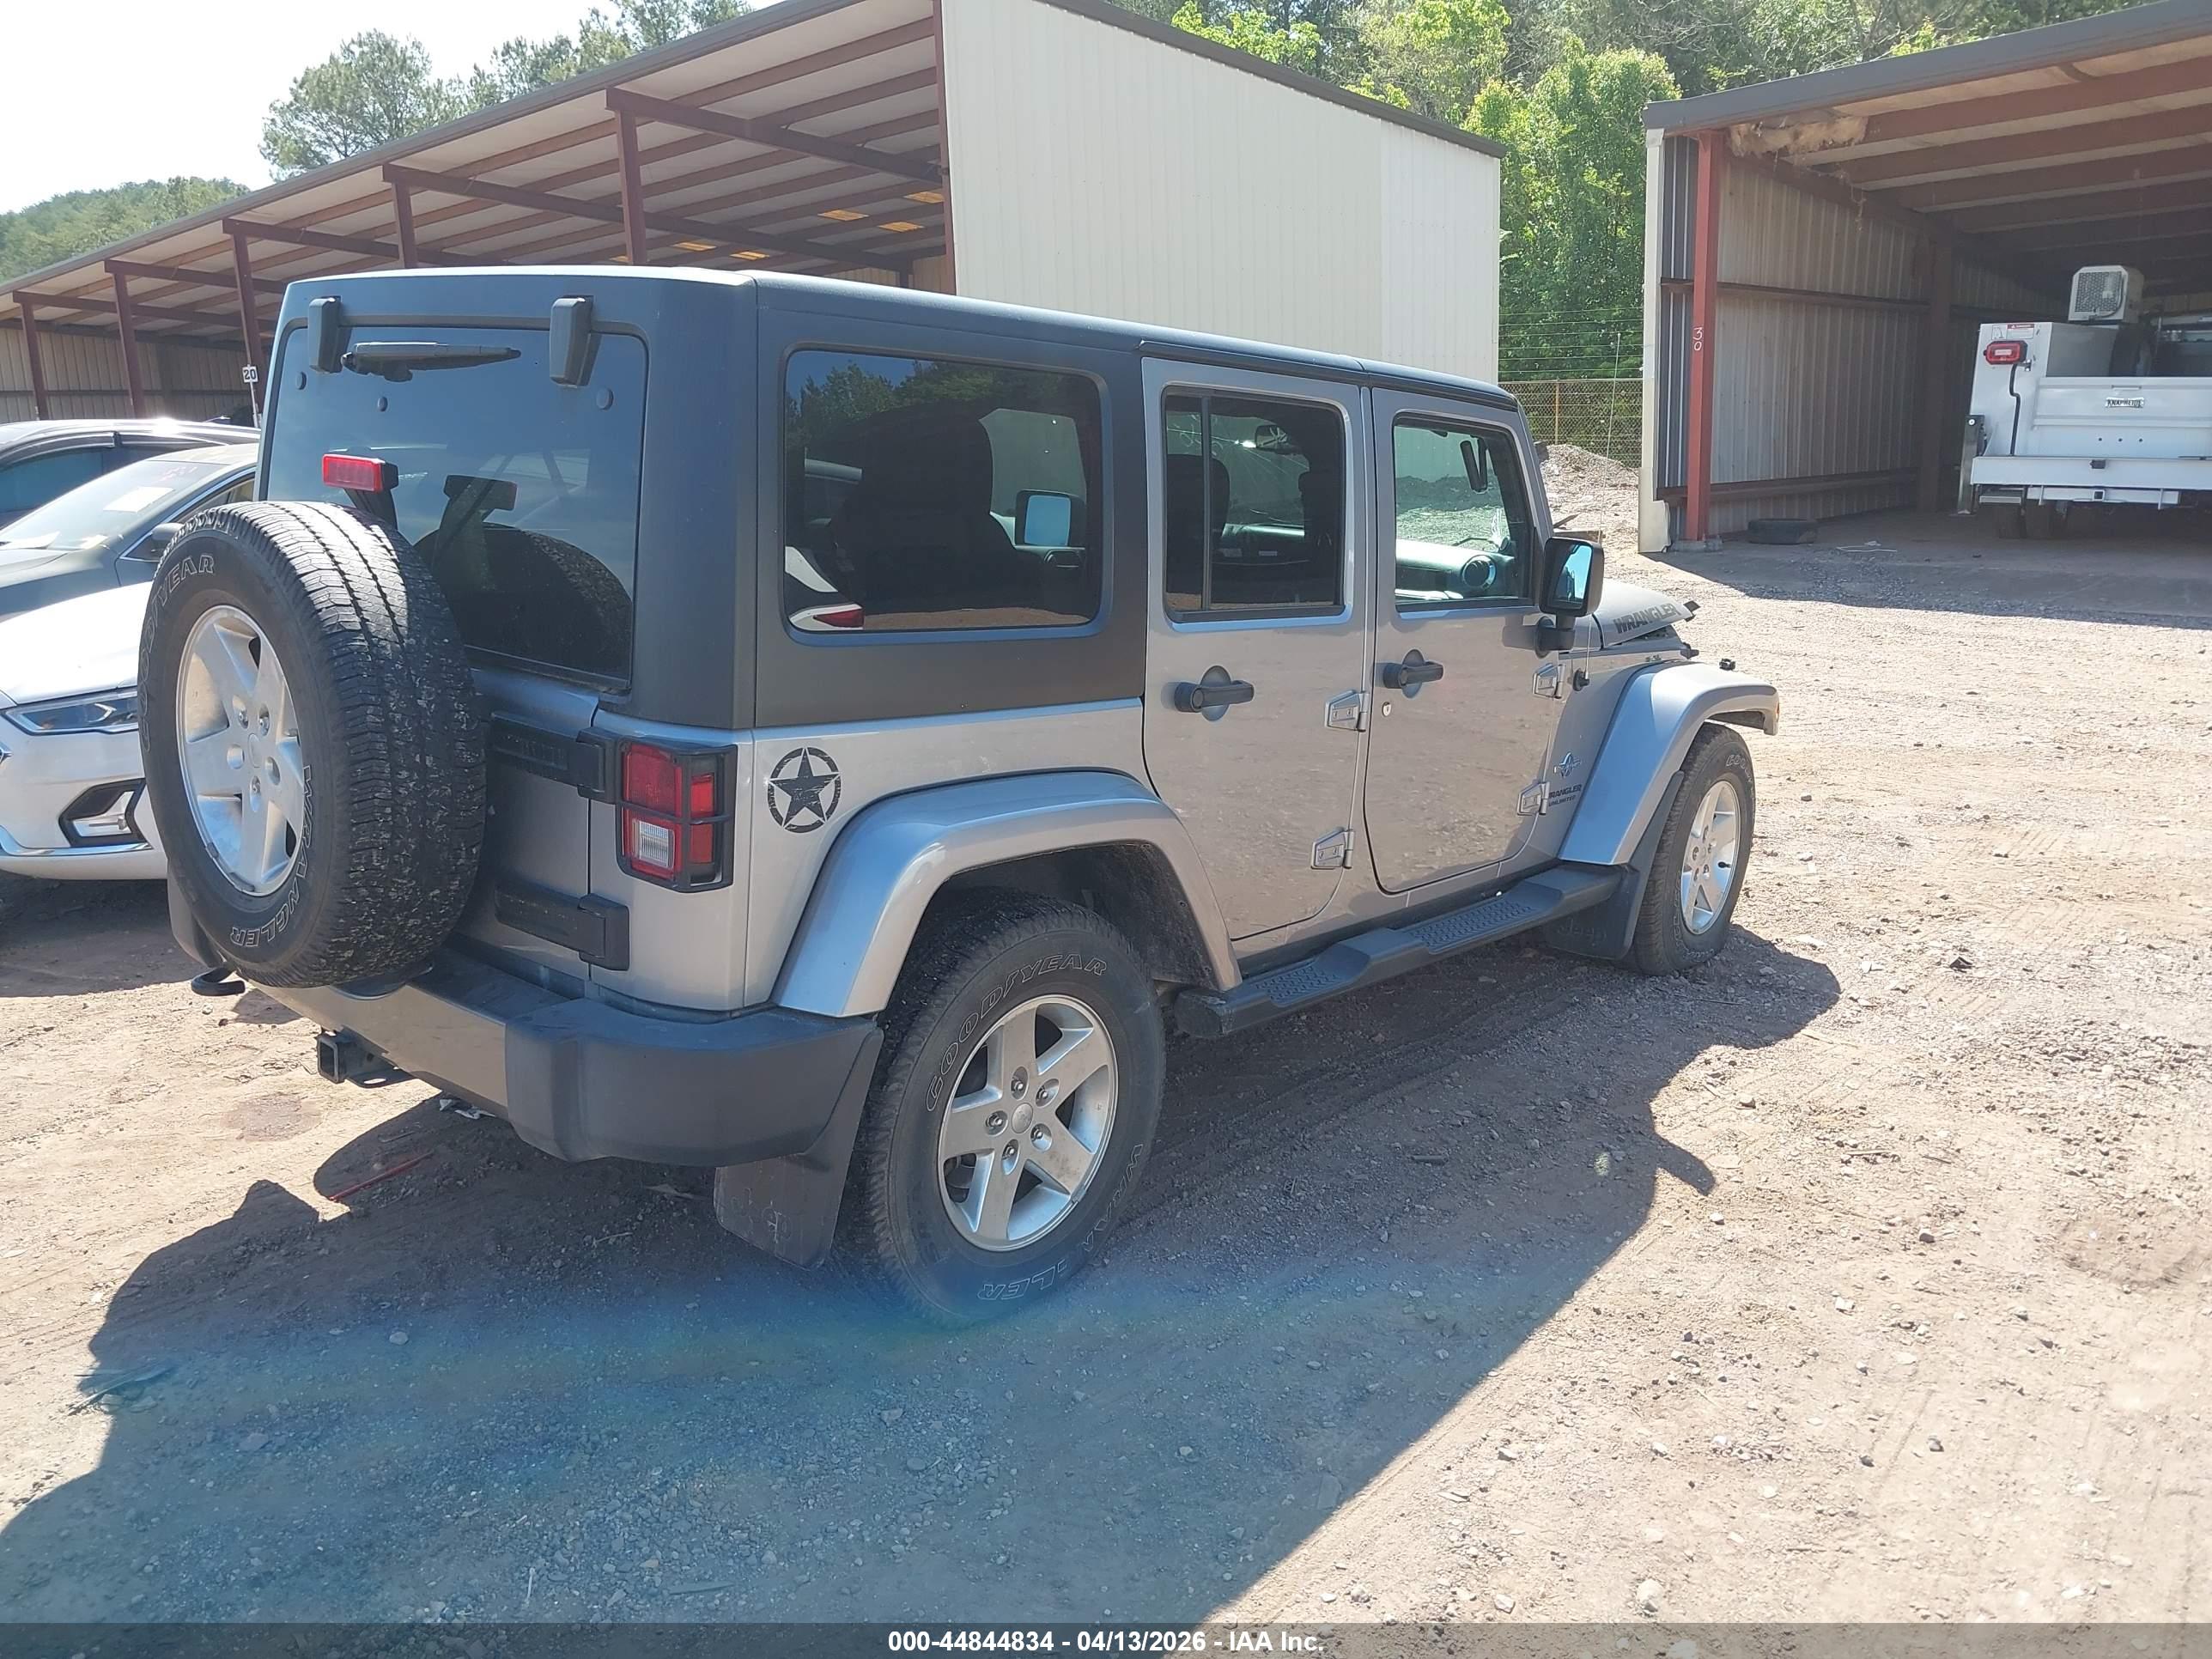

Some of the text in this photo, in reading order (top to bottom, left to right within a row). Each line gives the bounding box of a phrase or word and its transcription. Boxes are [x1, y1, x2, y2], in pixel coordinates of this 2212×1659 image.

[244, 369, 257, 380] 20
[1613, 603, 1682, 634] WRANGLER
[229, 765, 313, 947] WRANGLER
[926, 953, 1108, 1112] GOODYEAR
